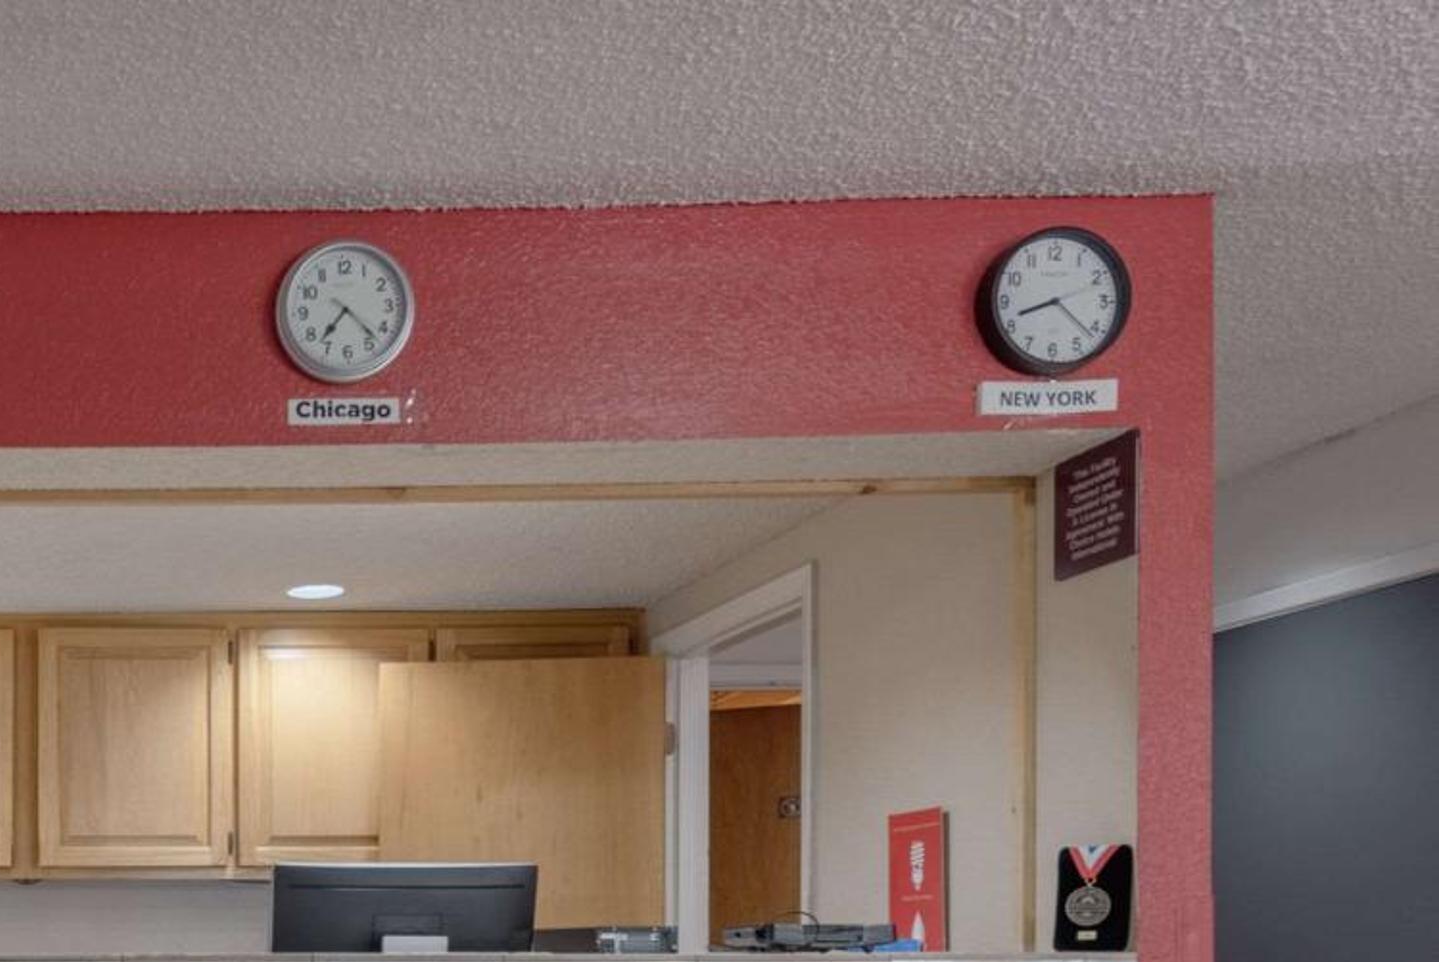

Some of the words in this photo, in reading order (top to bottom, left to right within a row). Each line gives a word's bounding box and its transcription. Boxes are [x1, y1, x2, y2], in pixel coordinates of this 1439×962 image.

[1048, 247, 1062, 261] 12
[1027, 254, 1036, 268] 11
[338, 261, 351, 275] 12
[1008, 272, 1021, 286] 10
[1092, 271, 1101, 285] 2
[376, 278, 386, 292] 2
[304, 287, 317, 299] 10
[385, 299, 393, 312] 3
[1000, 295, 1009, 309] 9
[1099, 295, 1108, 309] 3
[298, 307, 308, 320] 9
[379, 321, 387, 333] 4
[306, 328, 316, 341] 8
[364, 338, 374, 351] 5
[1024, 337, 1033, 350] 7
[1048, 343, 1057, 356] 6
[1072, 338, 1081, 351] 5
[343, 346, 353, 358] 6
[1000, 392, 1040, 407] NEW
[1047, 391, 1096, 406] YORK
[296, 401, 391, 421] Chicago
